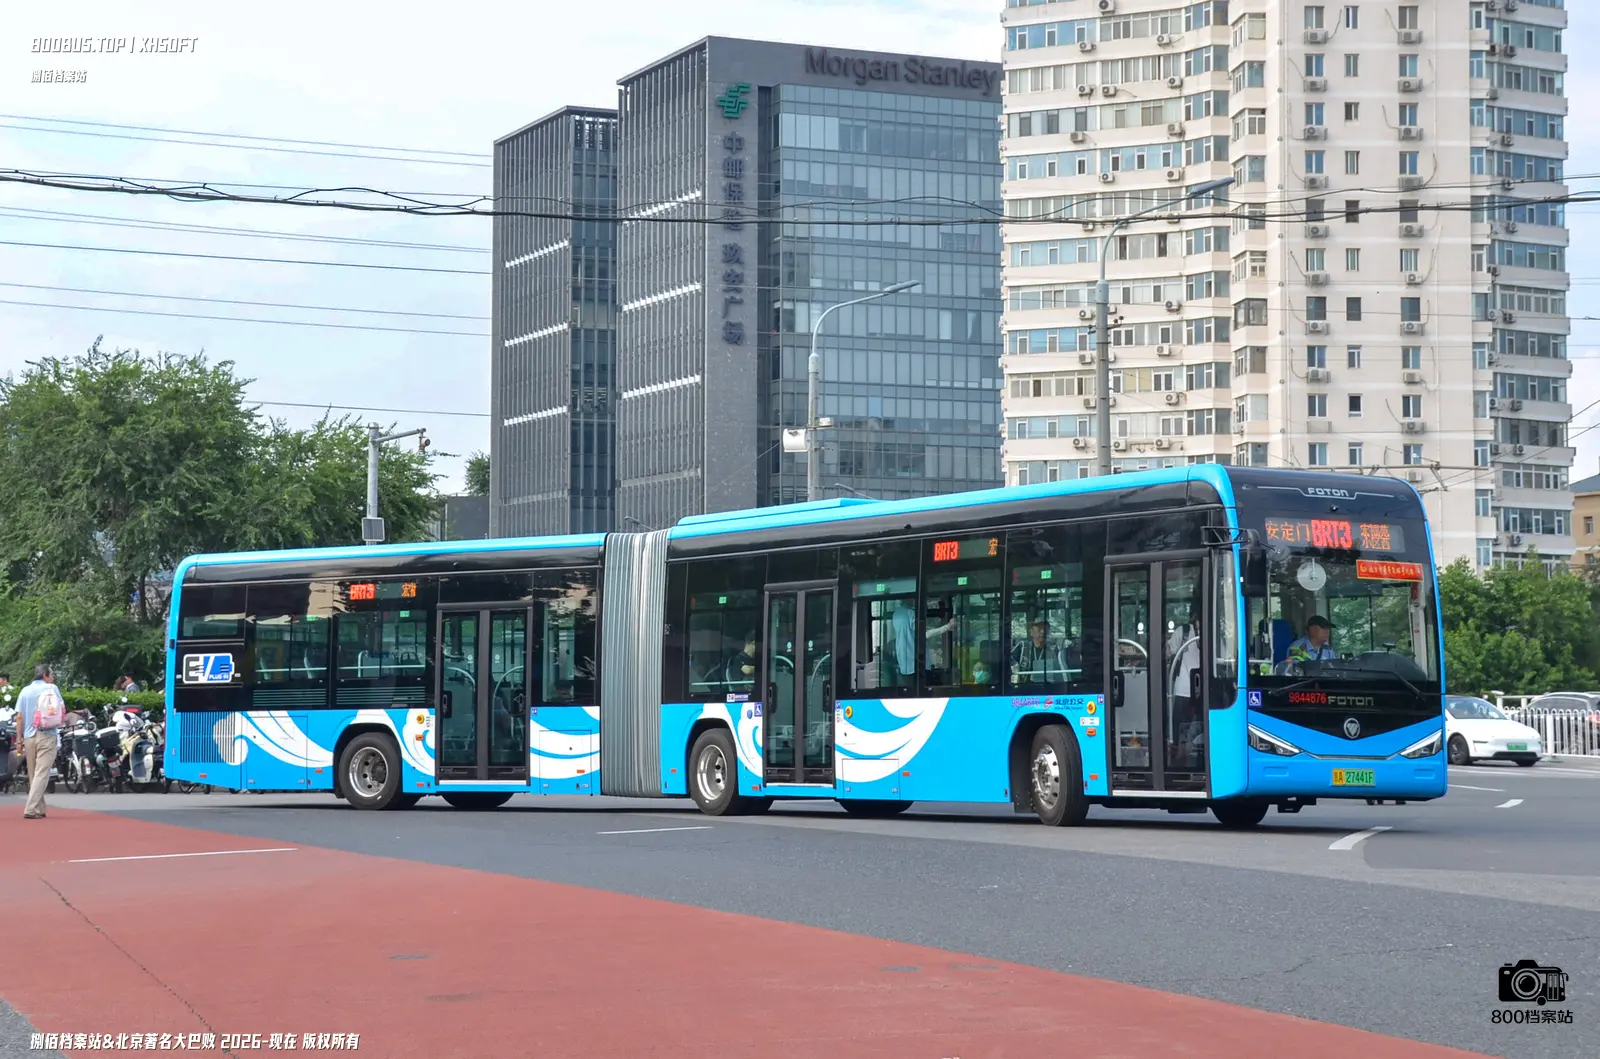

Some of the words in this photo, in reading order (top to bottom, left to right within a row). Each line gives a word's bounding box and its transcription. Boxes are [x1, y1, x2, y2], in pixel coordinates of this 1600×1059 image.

[804, 48, 900, 86] Morgan
[904, 57, 997, 96] Stanley
[1307, 487, 1349, 497] FOTON
[1265, 520, 1311, 542] 安定门
[1310, 519, 1353, 549] BRT3
[934, 541, 959, 561] BRT3
[349, 583, 376, 600] BRT3
[1288, 691, 1327, 704] 9844876
[1327, 695, 1375, 706] FOTON
